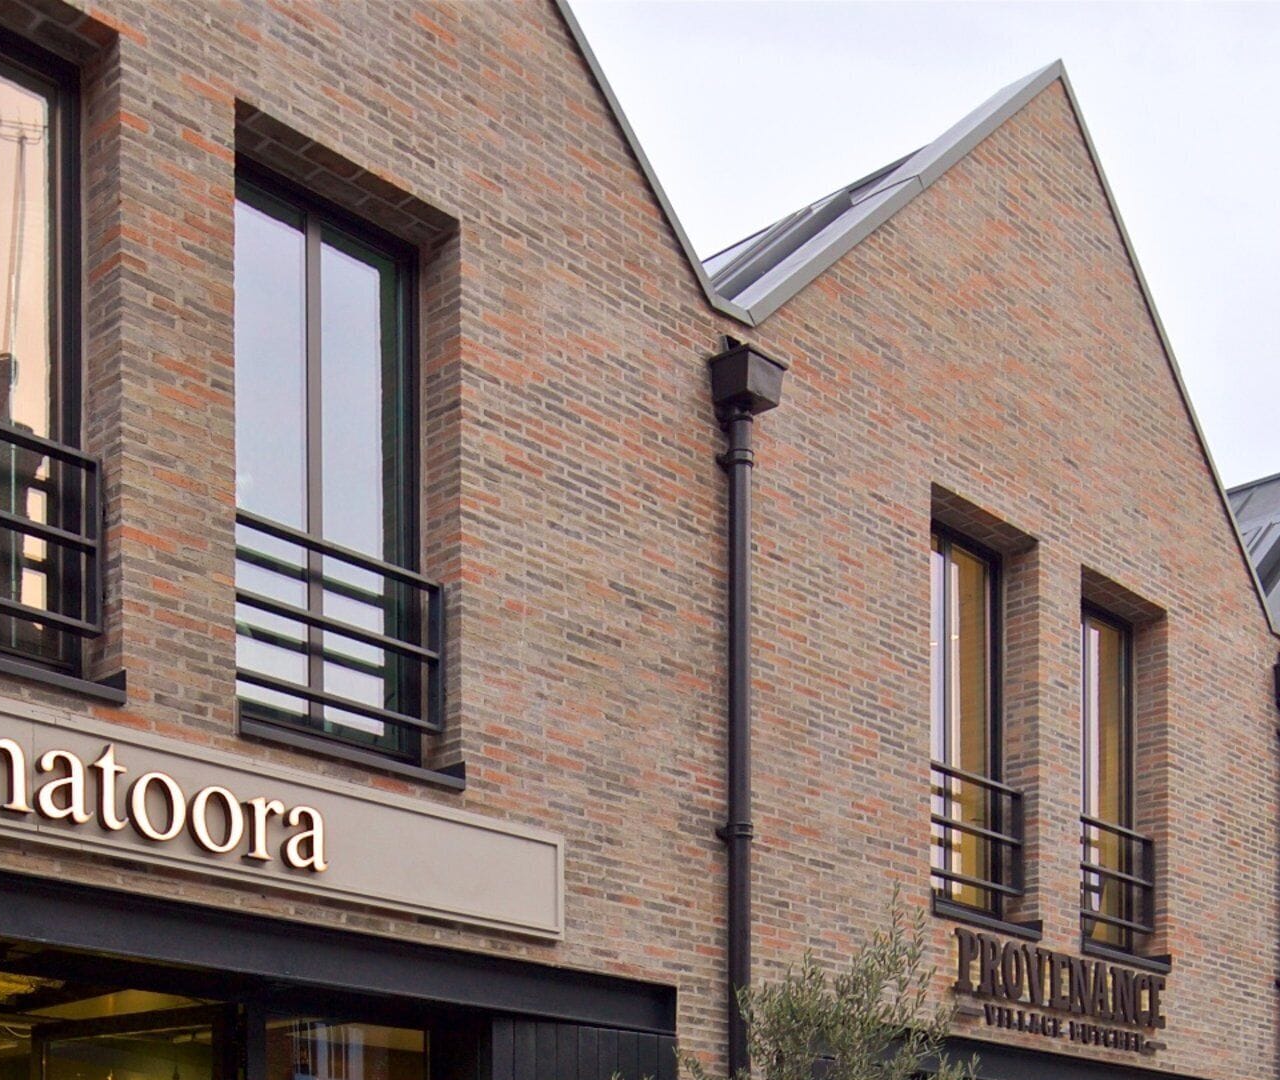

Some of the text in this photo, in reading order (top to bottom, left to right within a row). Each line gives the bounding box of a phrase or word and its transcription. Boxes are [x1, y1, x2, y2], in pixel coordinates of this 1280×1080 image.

[951, 927, 1167, 1030] PROVENANCE
[984, 1003, 1145, 1053] VILLAGE BUTCHER
